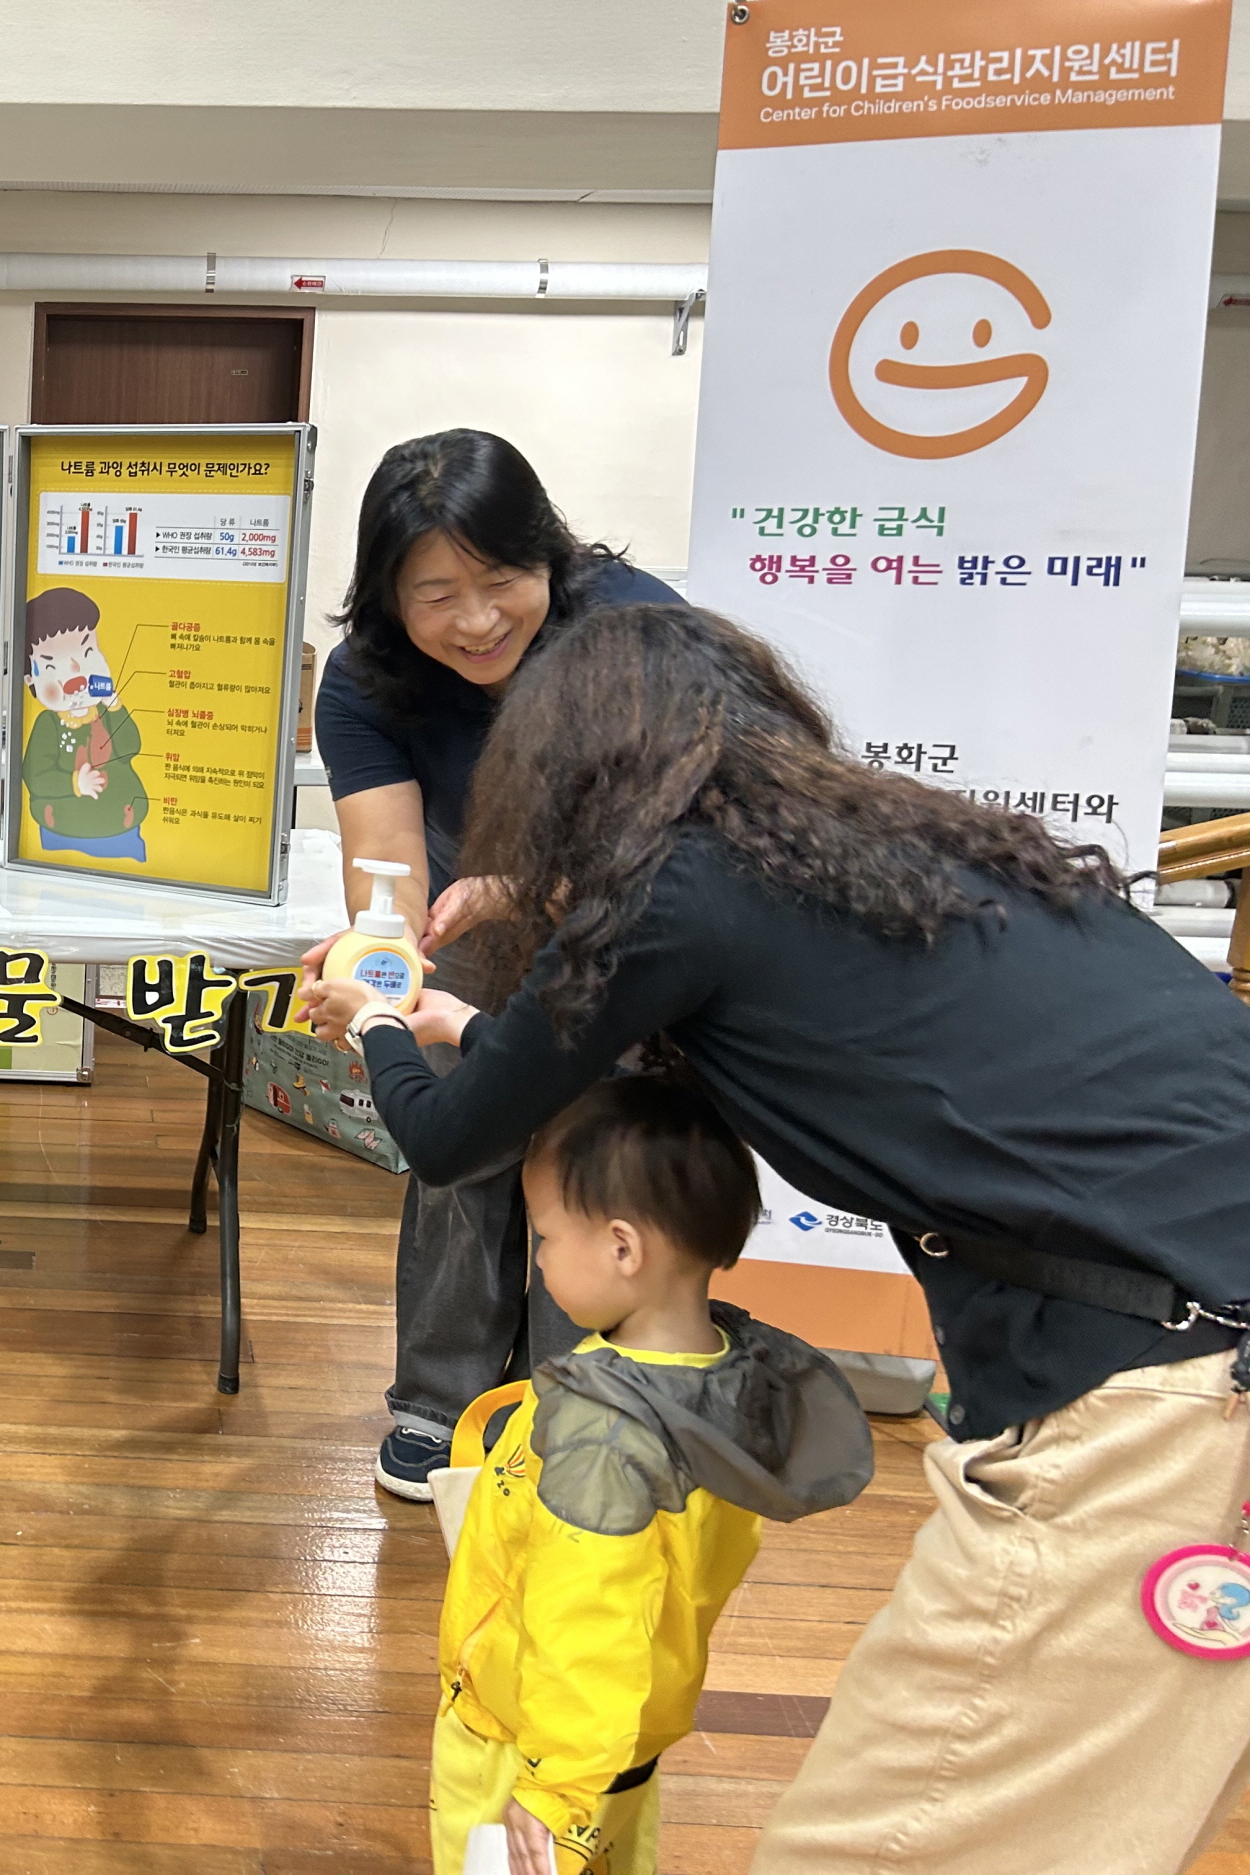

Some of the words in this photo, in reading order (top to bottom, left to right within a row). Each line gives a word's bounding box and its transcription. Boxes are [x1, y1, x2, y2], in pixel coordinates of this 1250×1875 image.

[766, 27, 843, 57] 봉화군
[761, 38, 1181, 99] 어린이급식관리지원센터
[759, 102, 818, 123] Center
[822, 100, 846, 119] for
[850, 96, 937, 117] Children's
[941, 91, 1050, 111] Foodservice
[1054, 84, 1175, 106] Management
[61, 461, 95, 476] 나트륨
[99, 461, 122, 477] 과잉
[126, 461, 163, 476] 섭취시
[165, 461, 201, 476] 무엇이
[203, 461, 270, 477] 문제인가요?
[250, 519, 269, 527] 나트륨
[731, 507, 863, 538] "건강한
[873, 506, 947, 538] 급식
[180, 532, 192, 540] 권장
[193, 532, 212, 540] 섭취량
[219, 532, 235, 542] 50g
[241, 533, 276, 543] 2,000mg
[162, 546, 180, 554] 한국인
[215, 546, 237, 557] 61.4g
[241, 548, 276, 558] 4,583mg
[749, 554, 857, 586] 행복을
[870, 555, 943, 586] 여는
[957, 556, 1032, 587] 밝은
[1047, 555, 1147, 587] 미래"
[171, 622, 201, 632] 골다공증
[212, 635, 238, 644] 나트륨과
[169, 670, 191, 679] 고혈압
[94, 681, 112, 692] 나트륨
[169, 680, 187, 689] 혈관이
[167, 708, 189, 718] 심장병
[191, 720, 210, 729] 혈관이
[212, 722, 238, 731] 손상되어
[165, 752, 180, 762] 위암
[860, 742, 959, 773] 봉화군
[172, 763, 190, 772] 음식에
[163, 797, 178, 806] 비만
